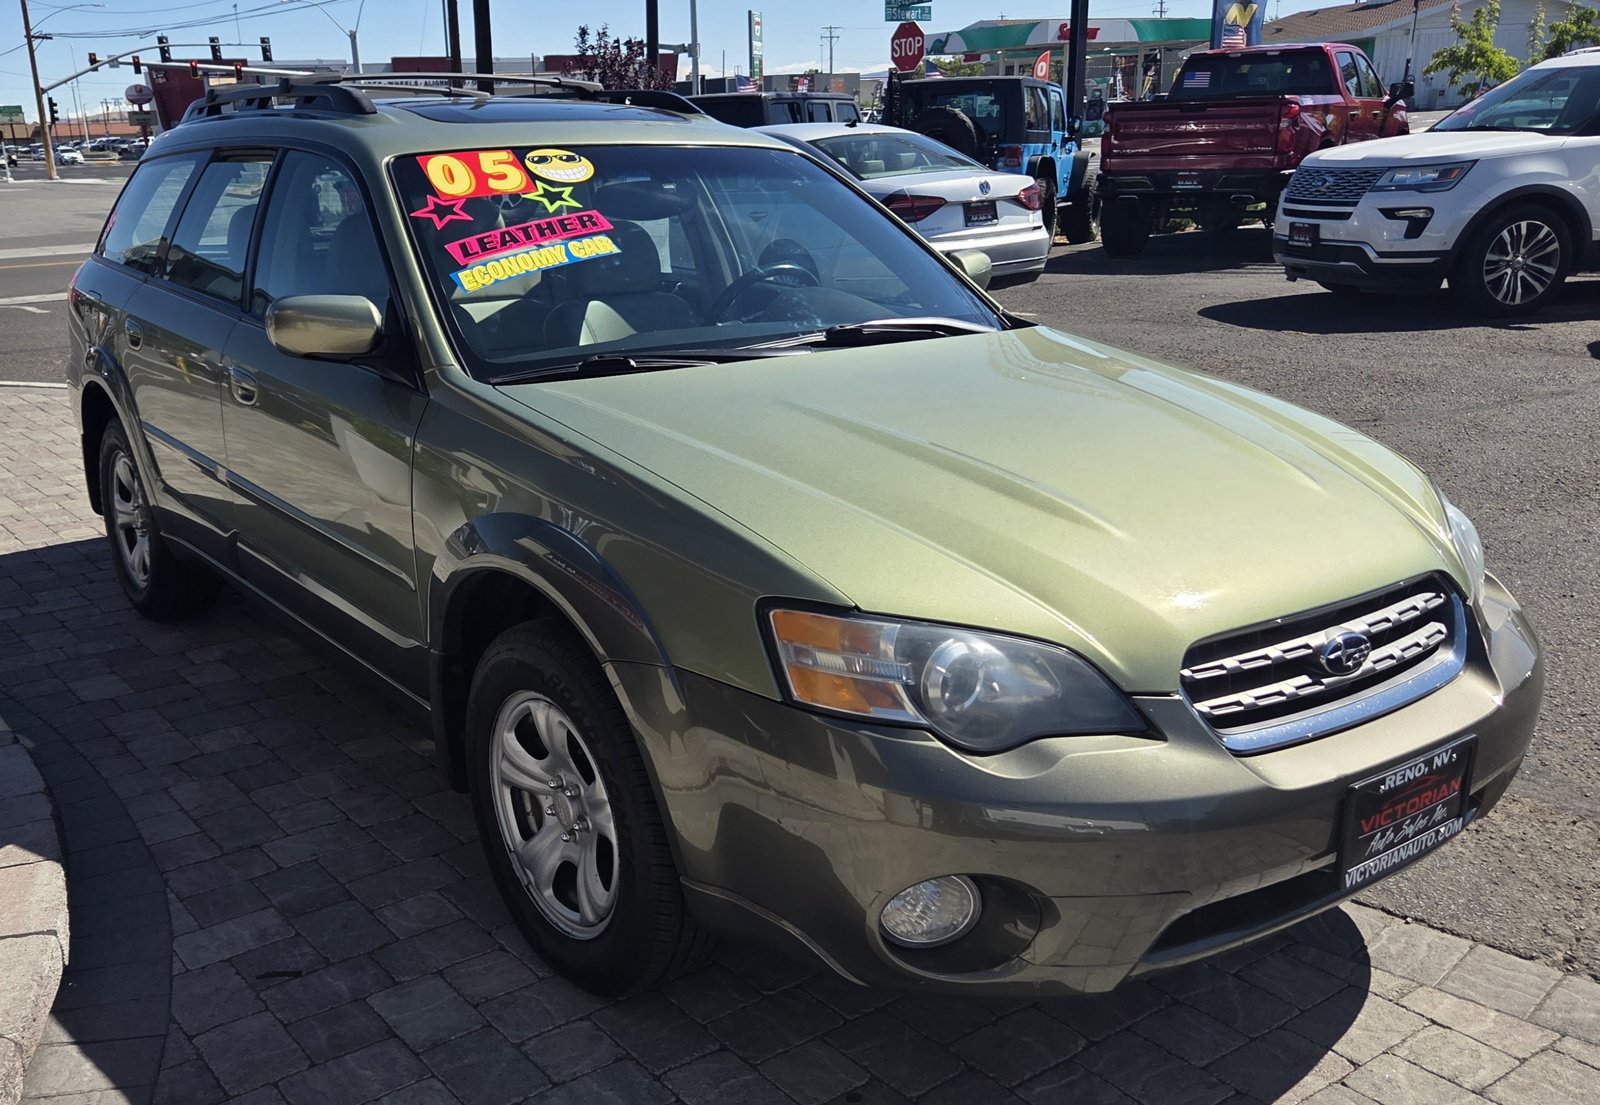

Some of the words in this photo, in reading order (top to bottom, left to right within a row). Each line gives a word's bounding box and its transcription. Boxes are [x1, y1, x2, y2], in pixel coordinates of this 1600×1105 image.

[892, 36, 923, 58] STOP
[426, 151, 527, 197] 05
[458, 213, 600, 259] LEATHER
[457, 245, 568, 292] ECONOMY
[567, 235, 619, 260] CAR
[1384, 762, 1429, 789] RENO,
[1360, 775, 1462, 833] VICTORIAN
[1344, 816, 1463, 888] VICTORIANAUTO.COM
[1365, 827, 1394, 857] Auto
[1394, 813, 1429, 843] Sales
